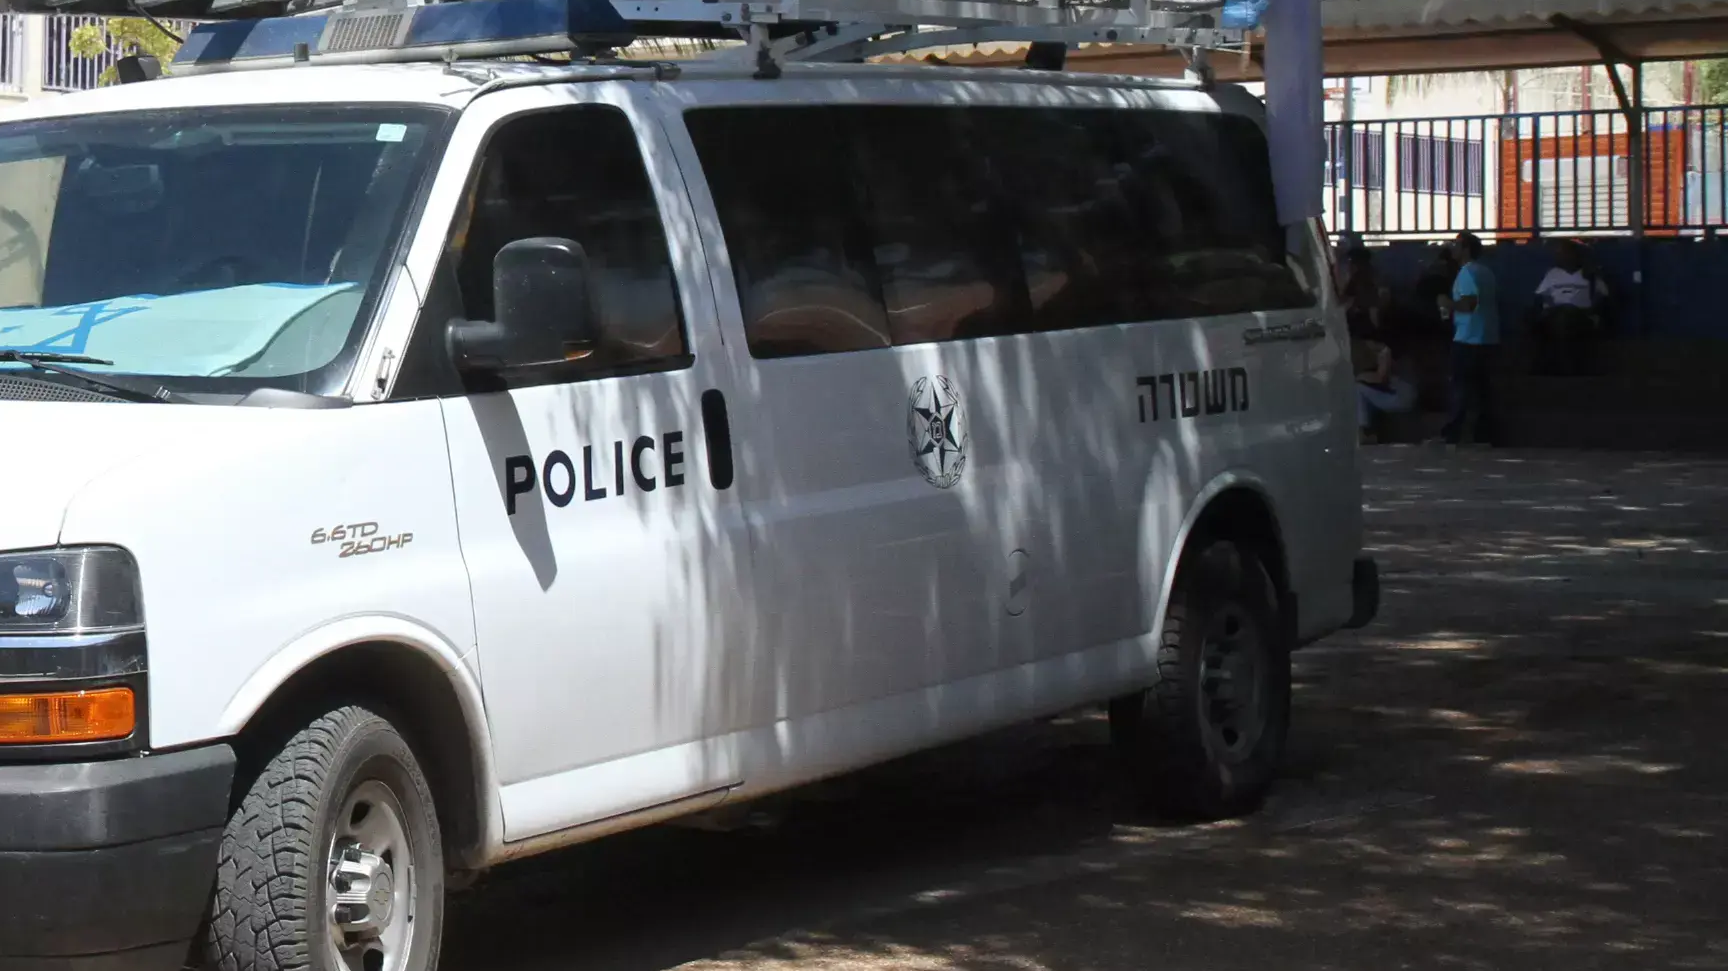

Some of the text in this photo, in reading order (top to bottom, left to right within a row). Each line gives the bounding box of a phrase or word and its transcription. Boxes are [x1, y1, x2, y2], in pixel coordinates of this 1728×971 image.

[1136, 366, 1250, 424] משטרה
[504, 431, 685, 516] POLICE
[311, 521, 379, 545] 6.6TD
[338, 532, 414, 559] 260HP
